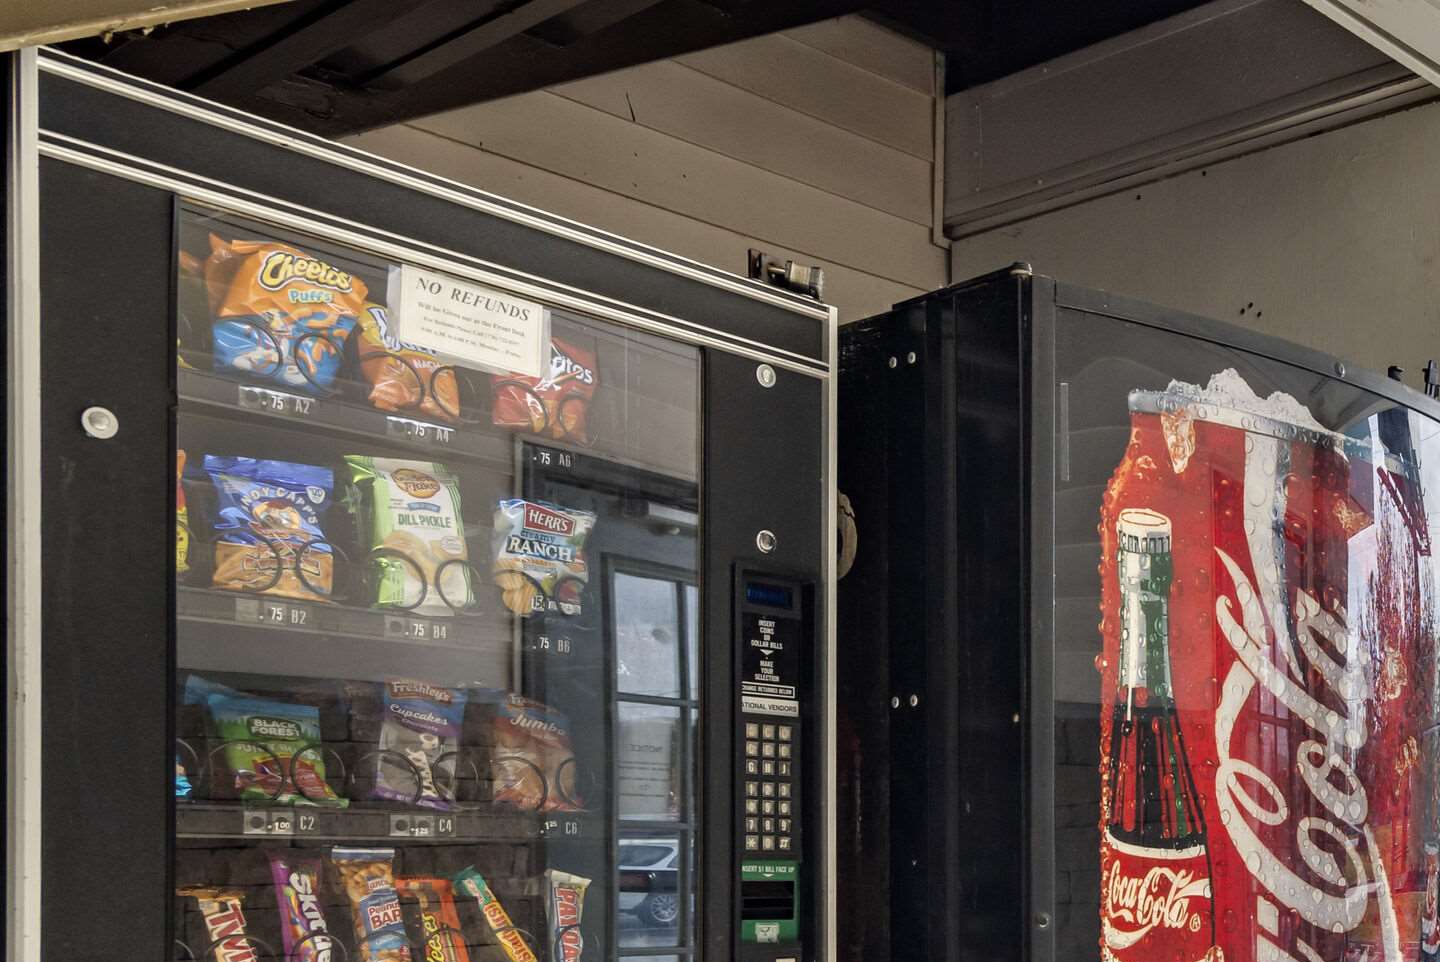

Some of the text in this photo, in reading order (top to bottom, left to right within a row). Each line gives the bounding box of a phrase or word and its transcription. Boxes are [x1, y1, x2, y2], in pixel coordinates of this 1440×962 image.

[259, 252, 351, 292] Cheetos
[288, 290, 333, 303] Puffs
[416, 277, 530, 322] NO REFUNDS
[295, 399, 310, 414] A2
[436, 429, 449, 443] A4
[398, 514, 452, 529] DILL PICKLE
[529, 509, 568, 531] HERR'S
[508, 536, 573, 562] RANCH
[291, 609, 307, 624] B2
[758, 619, 776, 628] INSERT
[433, 625, 447, 639] B4
[389, 703, 448, 725] Cupcakes
[768, 703, 797, 713] VENDORS
[251, 726, 301, 737] FOREST
[253, 718, 297, 730] BLACK
[509, 712, 566, 736] Jumbo
[299, 815, 314, 830] C2
[439, 818, 452, 833] C4
[1107, 859, 1197, 932] Coca-Cola
